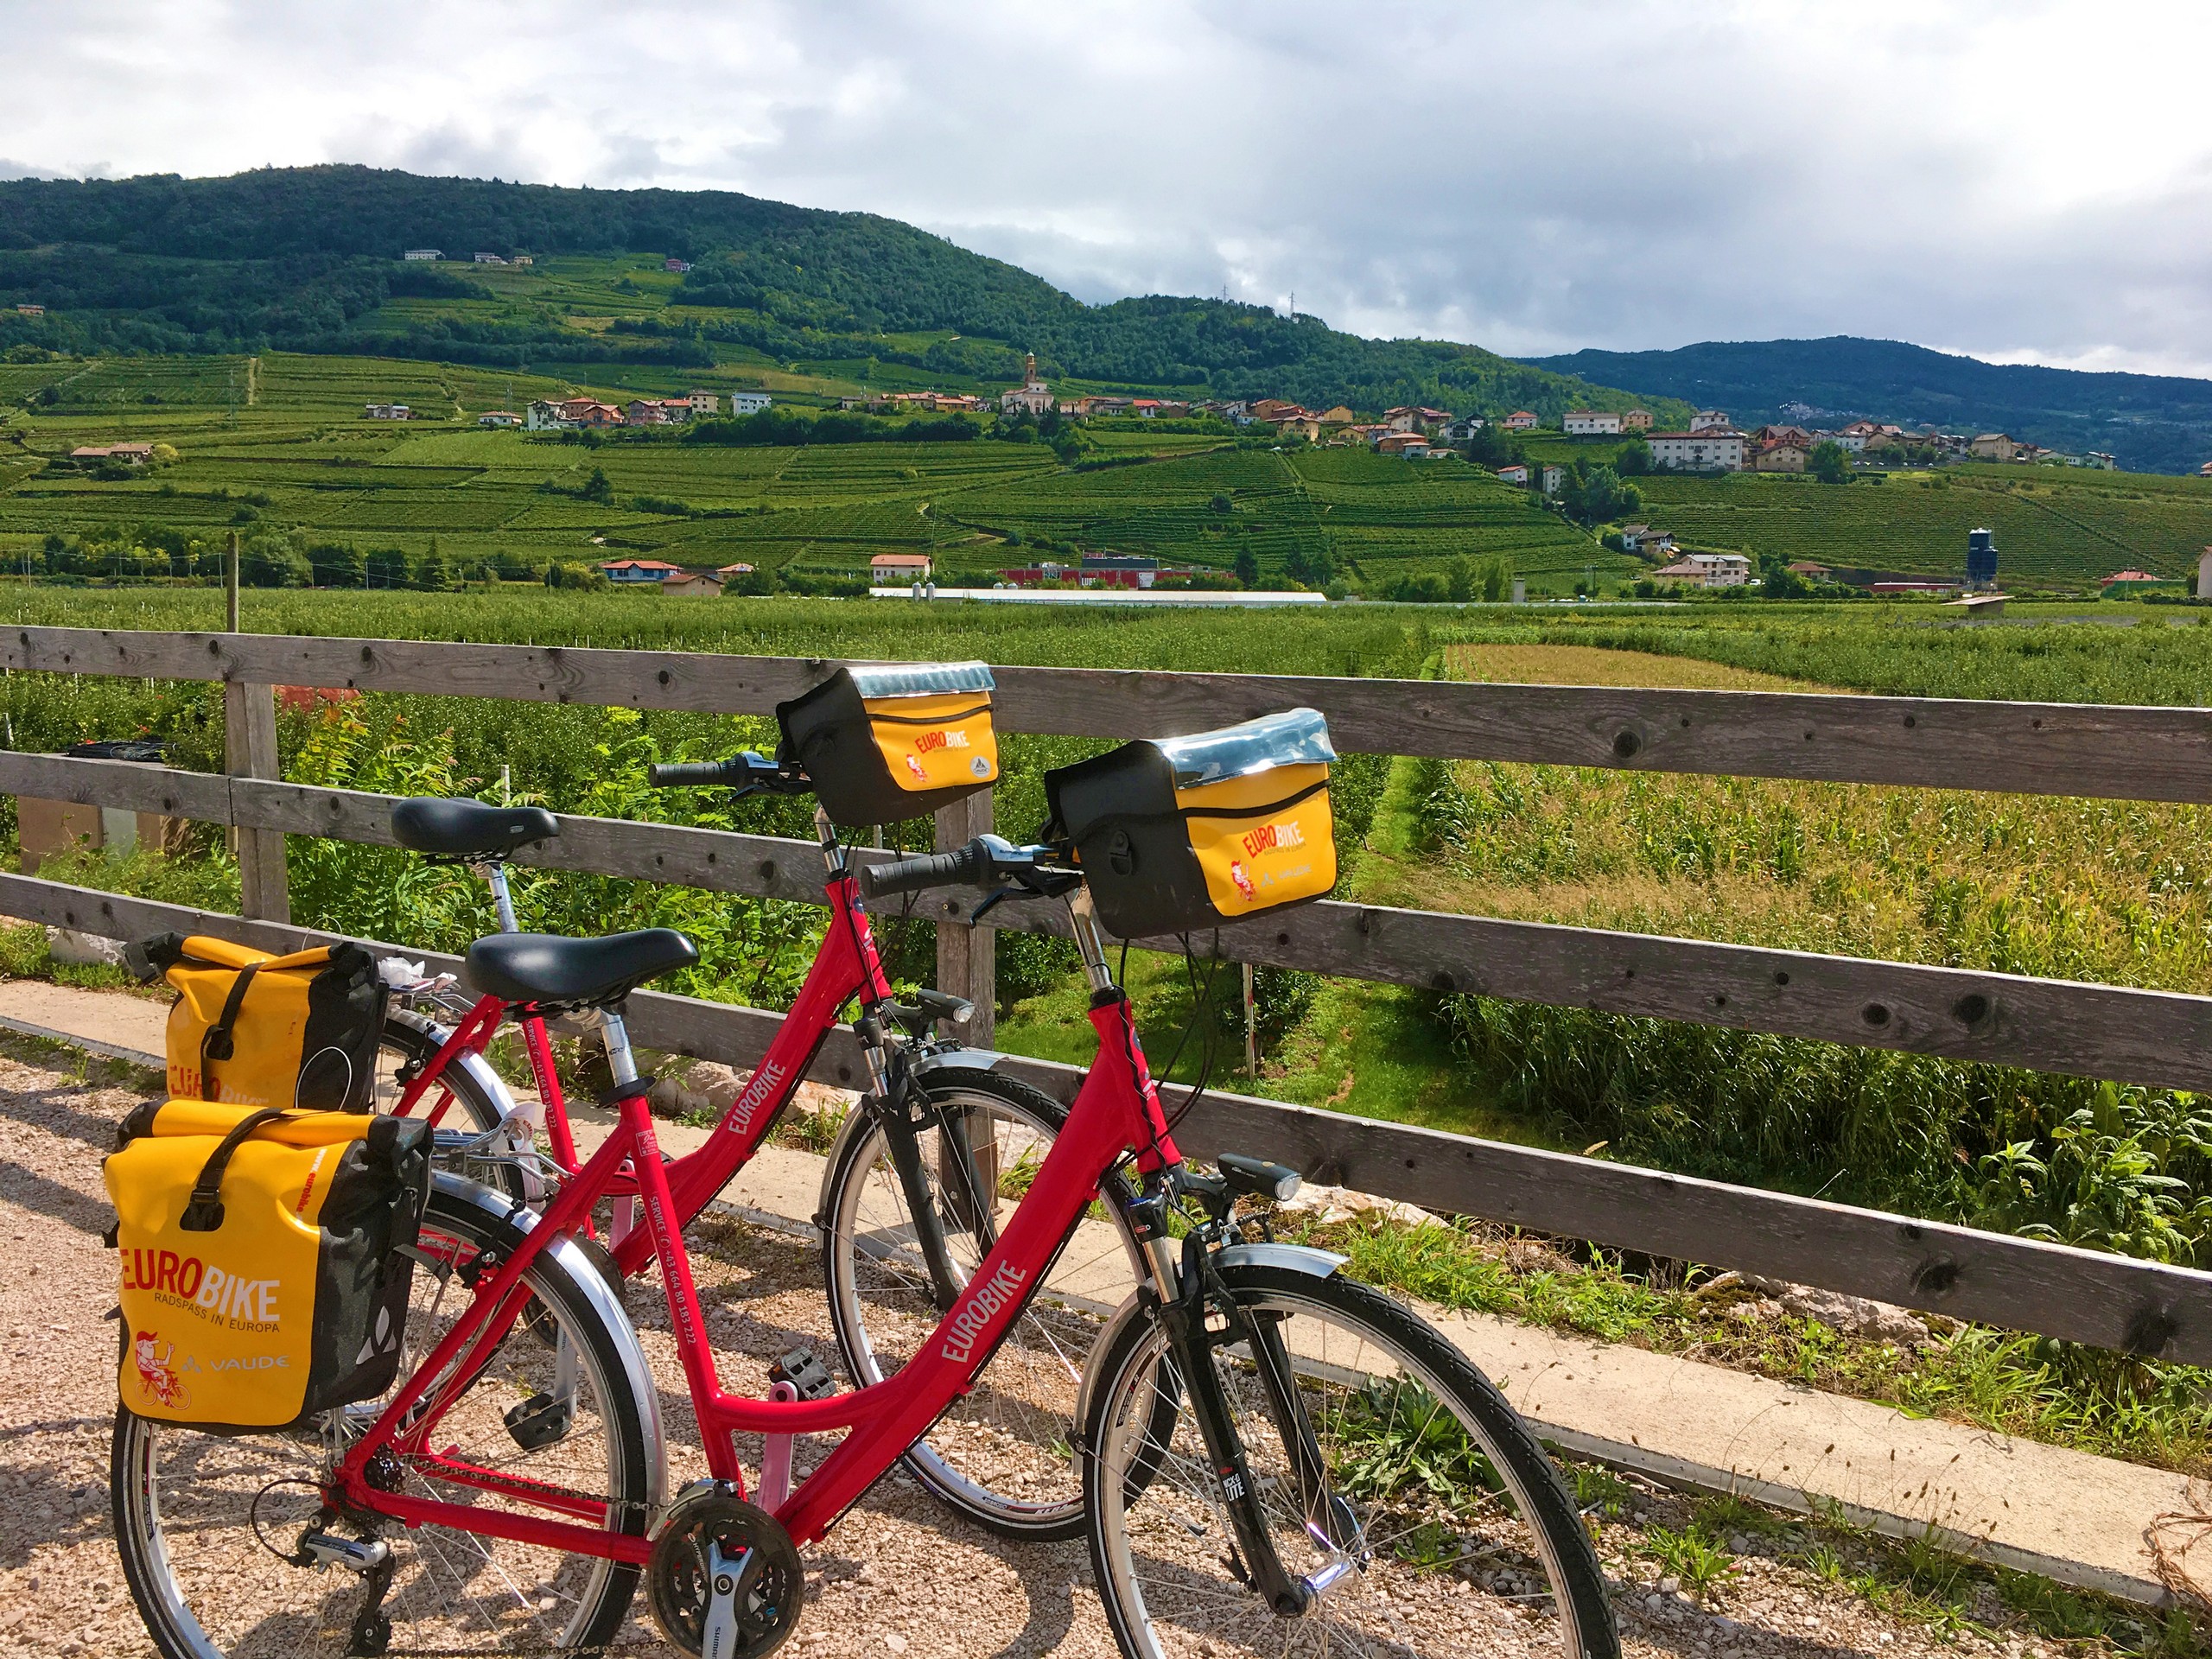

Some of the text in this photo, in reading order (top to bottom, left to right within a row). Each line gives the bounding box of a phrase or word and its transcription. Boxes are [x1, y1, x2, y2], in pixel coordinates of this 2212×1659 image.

[914, 730, 969, 754] EUROBIKE
[1243, 821, 1304, 859] EUROBIKE
[526, 1020, 538, 1047] SERVICE
[543, 1089, 550, 1099] 80
[548, 1114, 557, 1128] 222
[728, 1058, 786, 1135] EUROBIKE
[120, 1249, 281, 1322] EUROBIKE
[649, 1196, 696, 1346] SERVICE +43 664 80 183 222
[154, 1293, 281, 1333] RADSPASS IN EUROPA
[941, 1259, 1027, 1363] EUROBIKE
[209, 1355, 290, 1372] VAUDE
[1225, 1481, 1245, 1502] LITE
